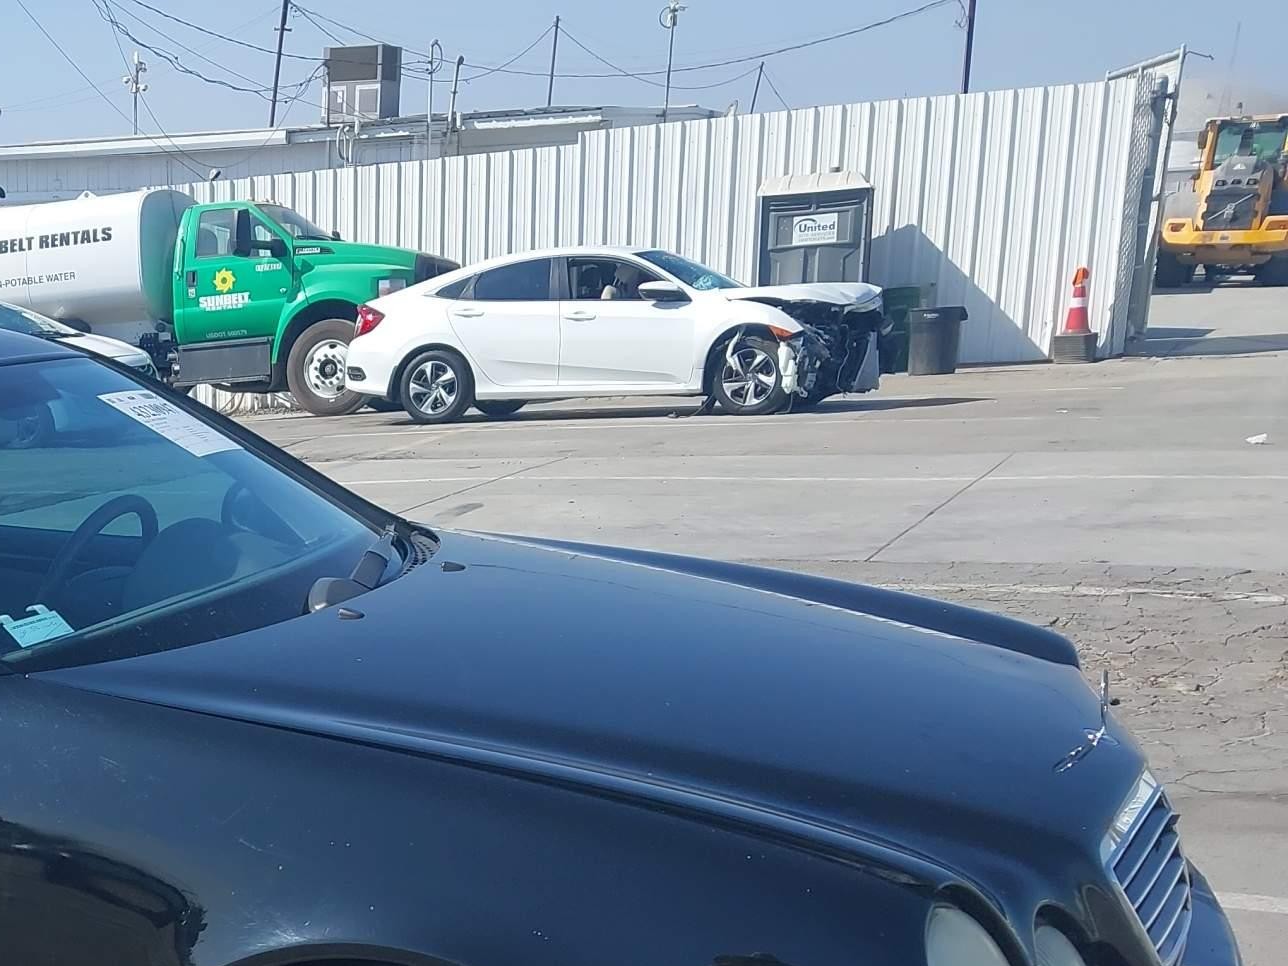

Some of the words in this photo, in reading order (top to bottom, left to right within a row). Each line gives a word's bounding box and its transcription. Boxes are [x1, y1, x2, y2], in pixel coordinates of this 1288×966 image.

[798, 220, 836, 233] United
[38, 226, 113, 250] RENTALS
[45, 271, 76, 283] WATER
[198, 291, 250, 308] SUNBELT
